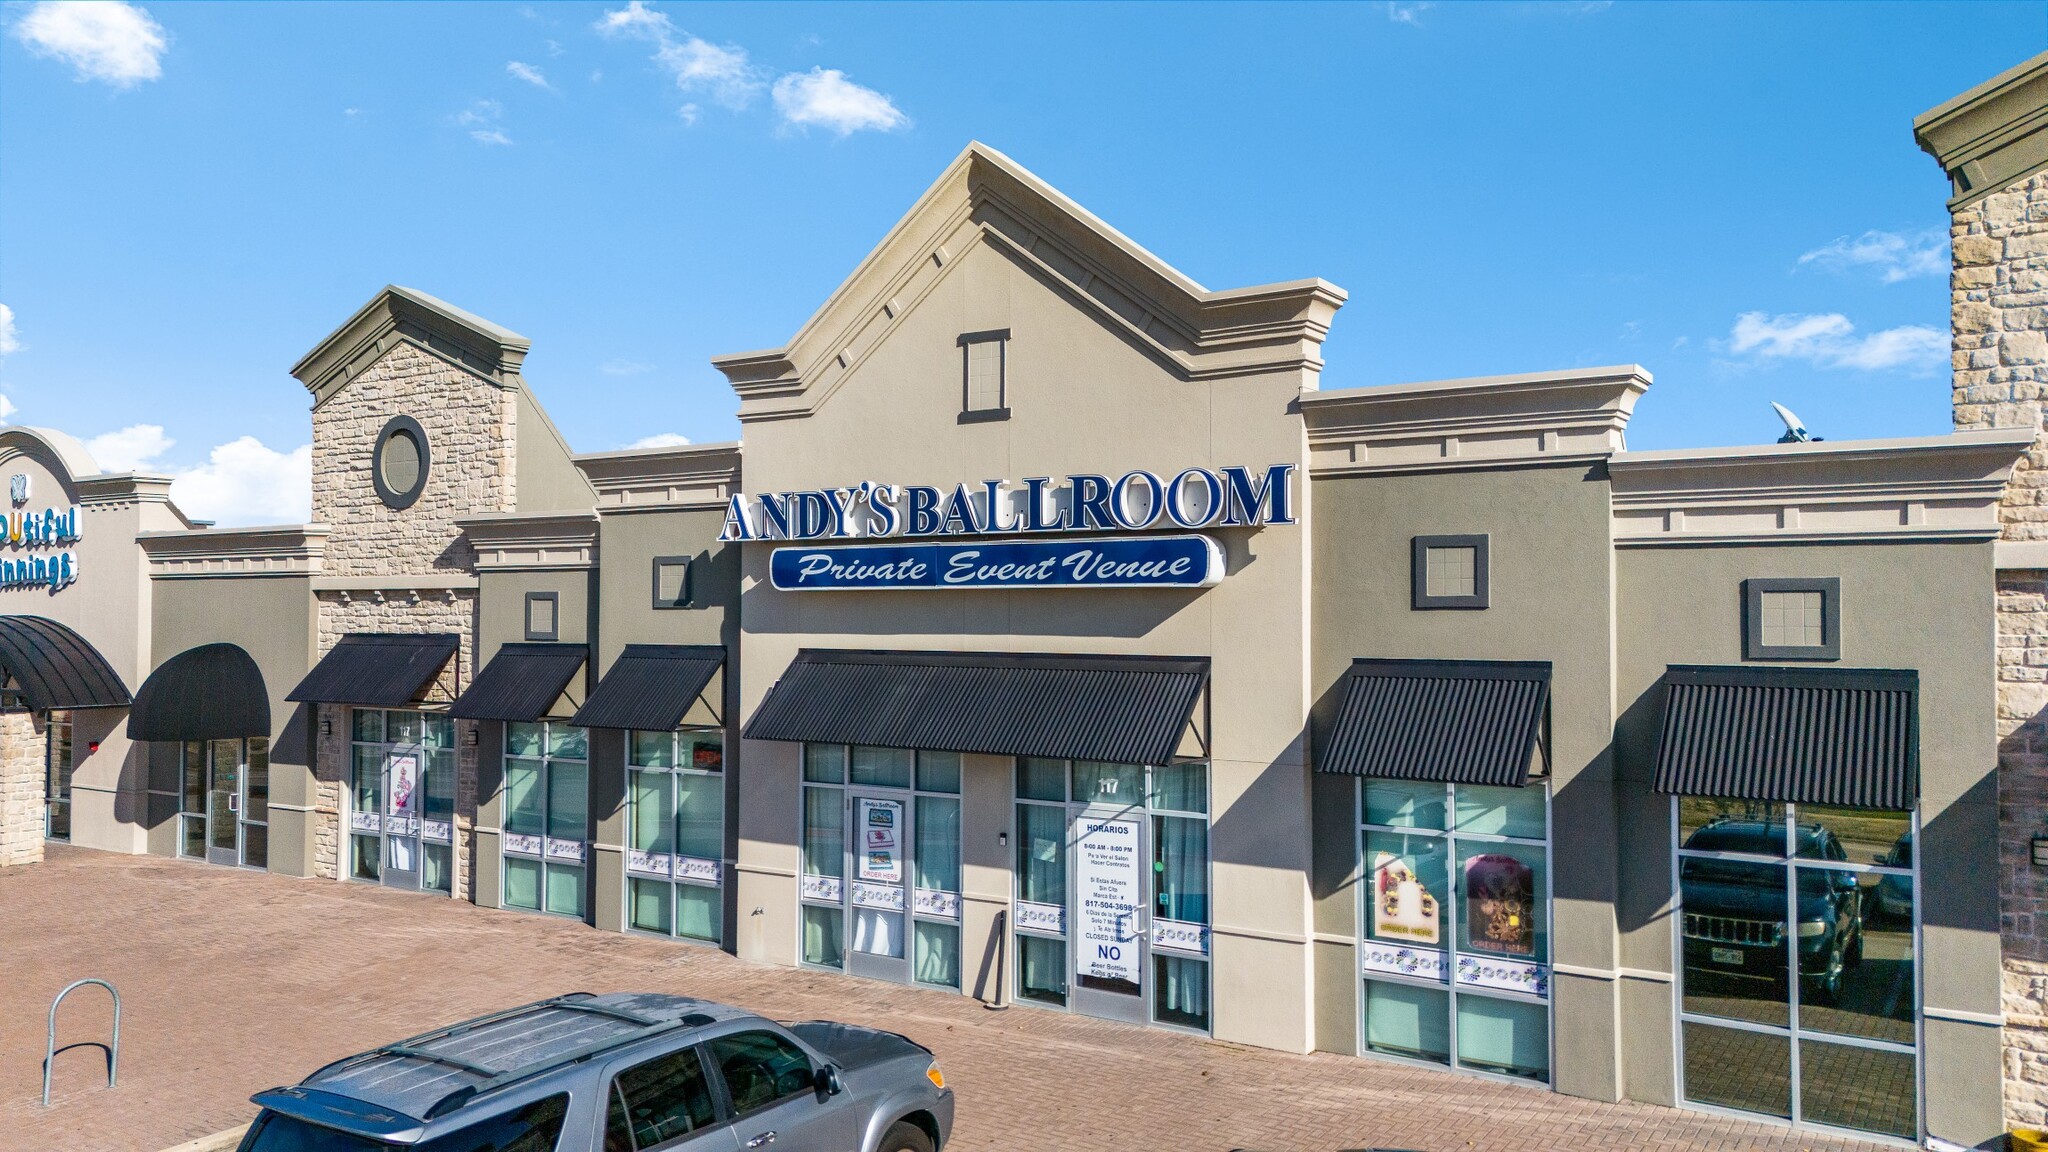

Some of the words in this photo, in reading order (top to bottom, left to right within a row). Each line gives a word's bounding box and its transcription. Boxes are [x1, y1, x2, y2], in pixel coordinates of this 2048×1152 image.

[716, 480, 899, 542] ANDY'S
[903, 463, 1300, 537] BALLROOM
[798, 553, 929, 585] Private
[943, 550, 1057, 585] Event
[1061, 548, 1193, 583] Venue
[1097, 777, 1119, 794] 117
[1086, 823, 1129, 835] HORARIOS
[1085, 899, 1133, 911] 817-504-3698
[1085, 932, 1109, 941] CLOSED
[1098, 944, 1121, 961] NO
